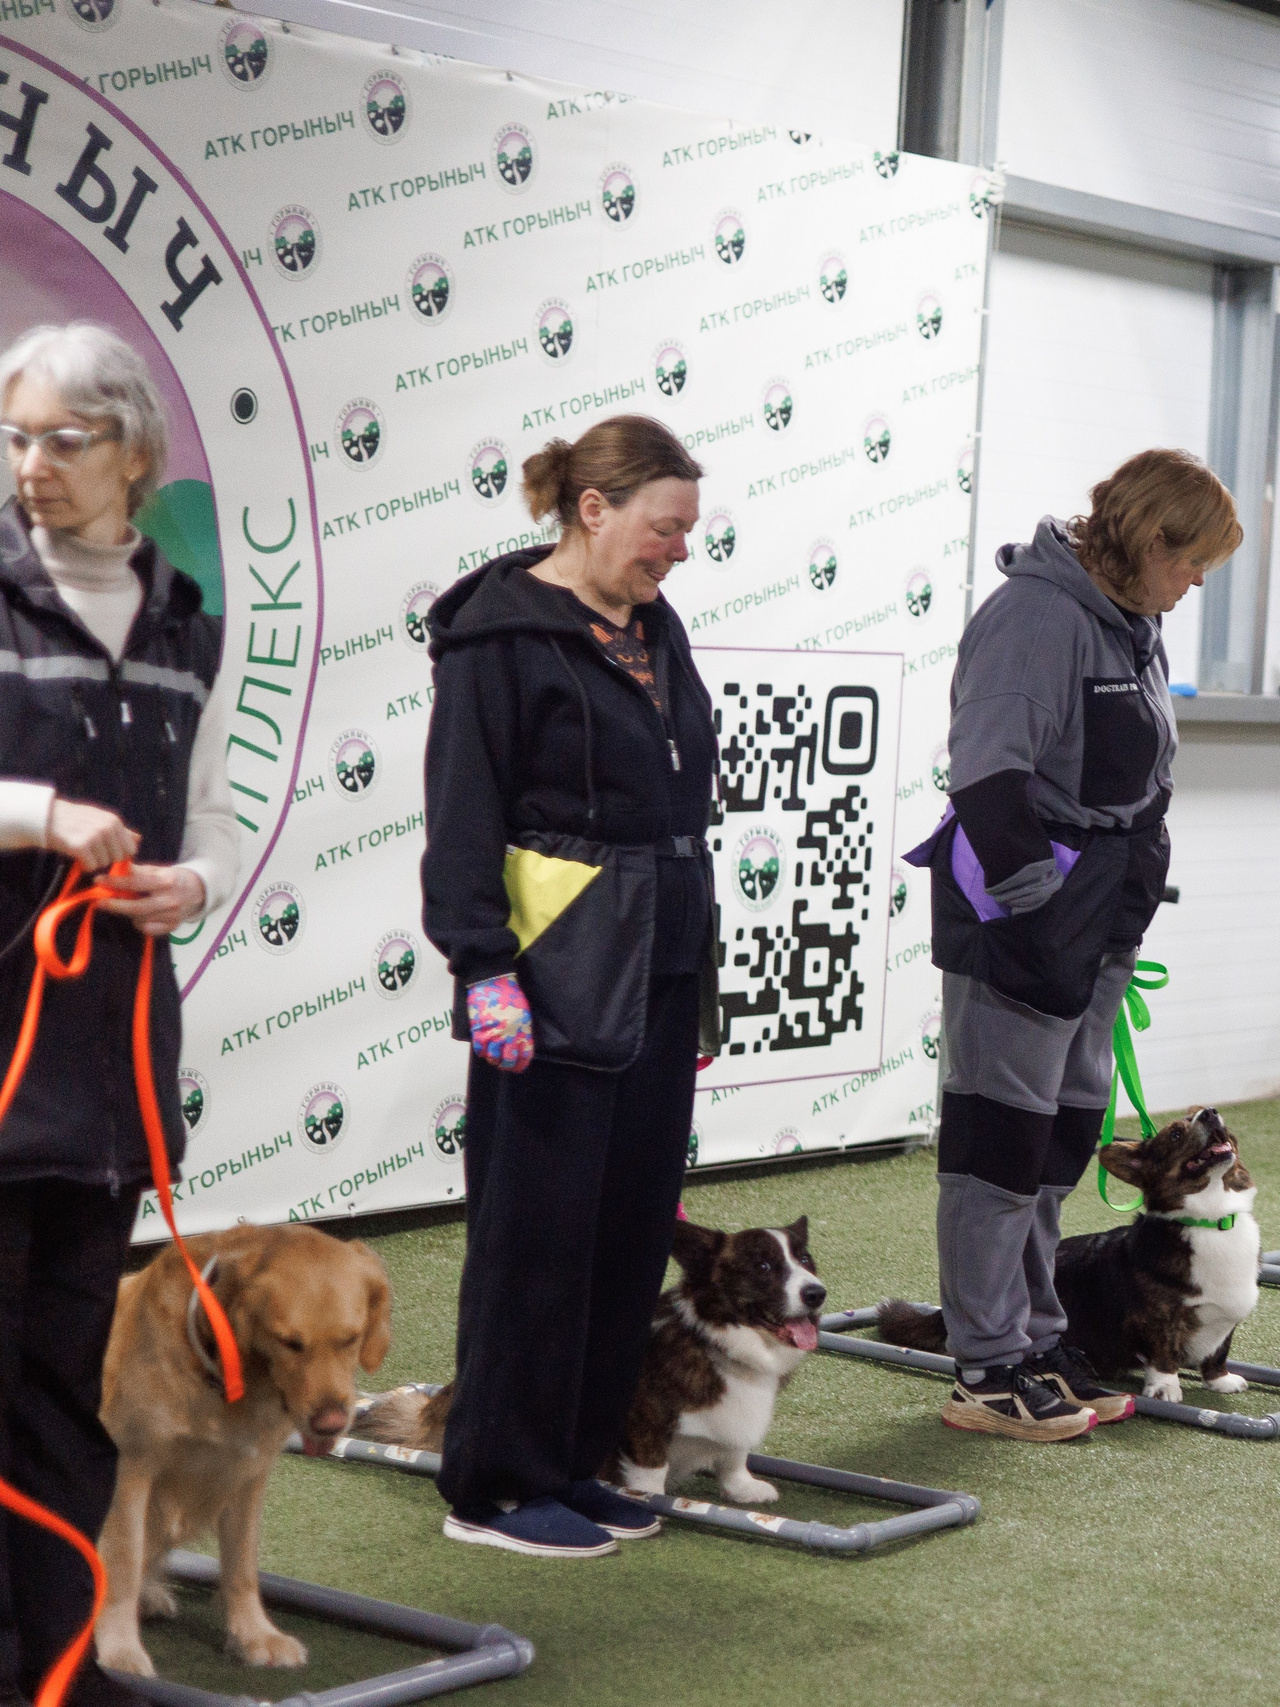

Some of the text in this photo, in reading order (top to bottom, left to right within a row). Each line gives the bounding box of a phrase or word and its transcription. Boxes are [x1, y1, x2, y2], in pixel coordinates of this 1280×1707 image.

[99, 55, 212, 94] ГОРЫНЫЧ
[204, 110, 355, 160] АТК ГОРЫНЫЧ
[663, 125, 777, 168] АТК ГОРЫНЫЧ
[348, 161, 486, 212] АТК ГОРЫНЫЧ
[758, 181, 787, 203] АТК
[464, 199, 592, 249] АТК ГОРЫНЫЧ
[586, 244, 705, 293] АТК ГОРЫНЫЧ
[271, 294, 401, 343] ТК ГОРЫНЫЧ
[699, 284, 810, 333] АТК ГОРЫНЫЧ
[396, 337, 529, 392] АТК ГОРЫНЫЧ
[804, 348, 833, 370] АТК
[522, 377, 646, 431] АТК ГОРЫНЫЧ
[748, 446, 855, 499] АТК ГОРЫНЫЧ
[322, 478, 461, 540] АТК ГОРЫНЫЧ
[849, 507, 876, 530] АТК
[457, 547, 493, 574] АТК
[691, 574, 800, 633] АТК ГОРЫНЫЧ
[826, 602, 898, 645] ГОРЫНЫЧ
[320, 624, 394, 666] РЫНЫЧ
[386, 691, 422, 720] АТК
[315, 811, 424, 872] АТК ГОРЫН
[220, 976, 366, 1056] АТК ГОРЫНЫЧ
[357, 1038, 394, 1070] АТК
[812, 1089, 840, 1116] АТК
[908, 1100, 934, 1125] АТК
[142, 1131, 293, 1219] АК ГОРЫНЫЧ
[288, 1141, 425, 1222] АТК ГОРЫНЫЧ
